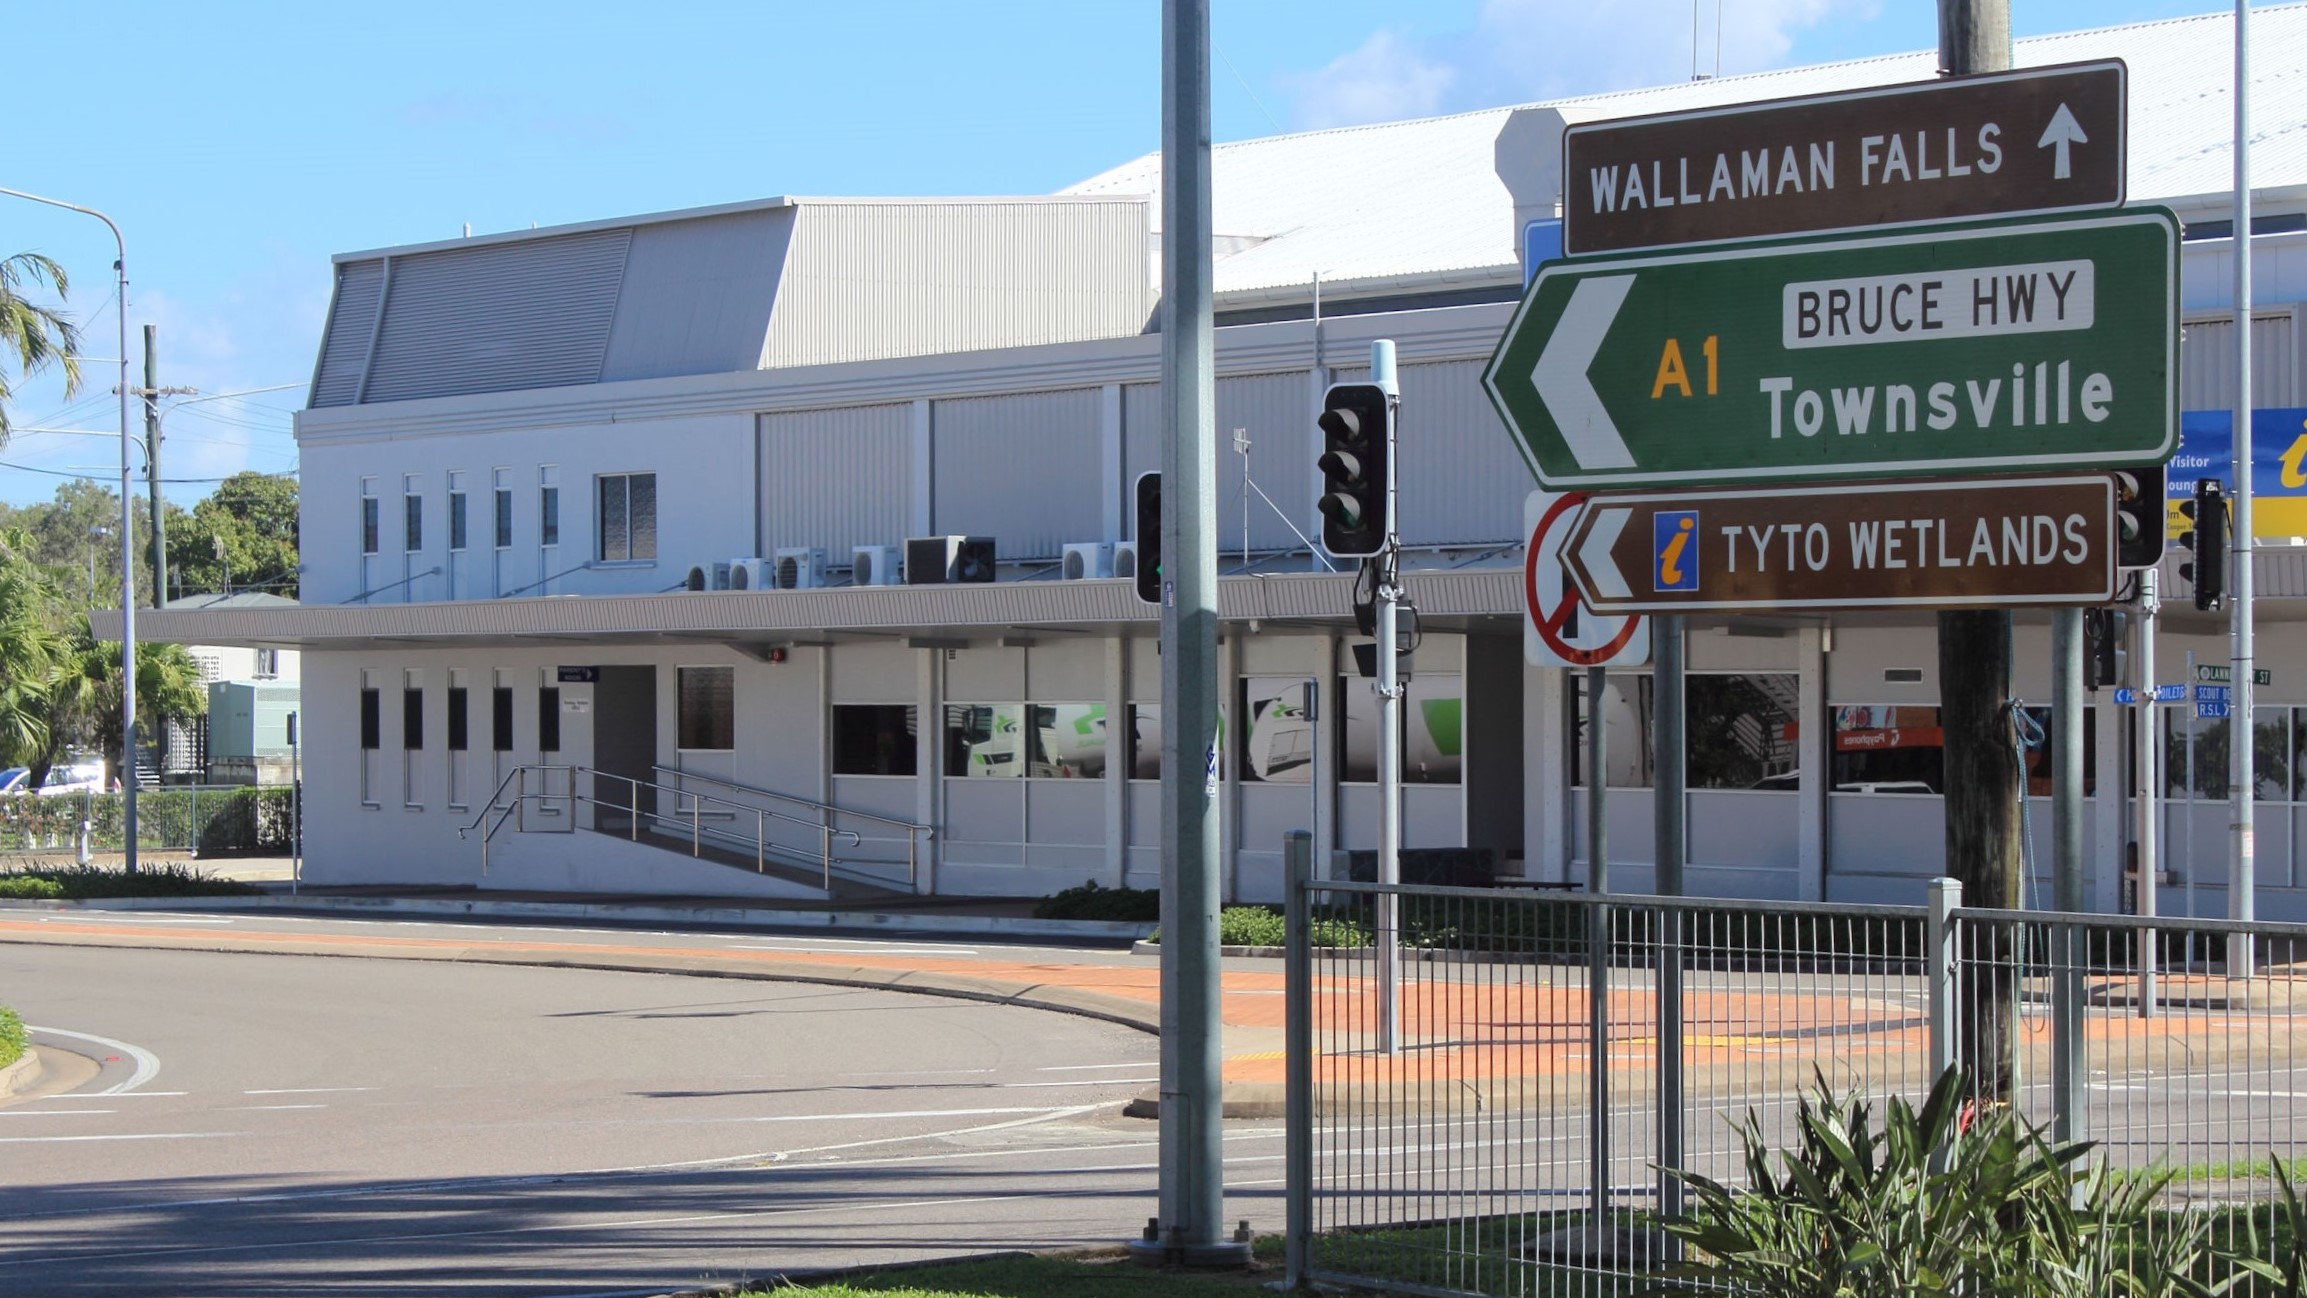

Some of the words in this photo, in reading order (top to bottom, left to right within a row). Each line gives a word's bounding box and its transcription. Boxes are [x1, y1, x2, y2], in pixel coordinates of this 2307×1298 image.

[1590, 141, 1834, 214] WALLAMAN
[1861, 122, 2002, 186] FALLS
[1797, 280, 1944, 339] BRUCE
[1972, 270, 2077, 328] HWY
[1651, 335, 1719, 400] A1
[1759, 359, 2113, 439] Townsville
[2169, 455, 2210, 468] Visitor
[1721, 522, 1829, 573] TYTO
[1849, 513, 2088, 569] WETLANDS
[2198, 687, 2219, 699] SCOUT
[2259, 671, 2269, 684] ST
